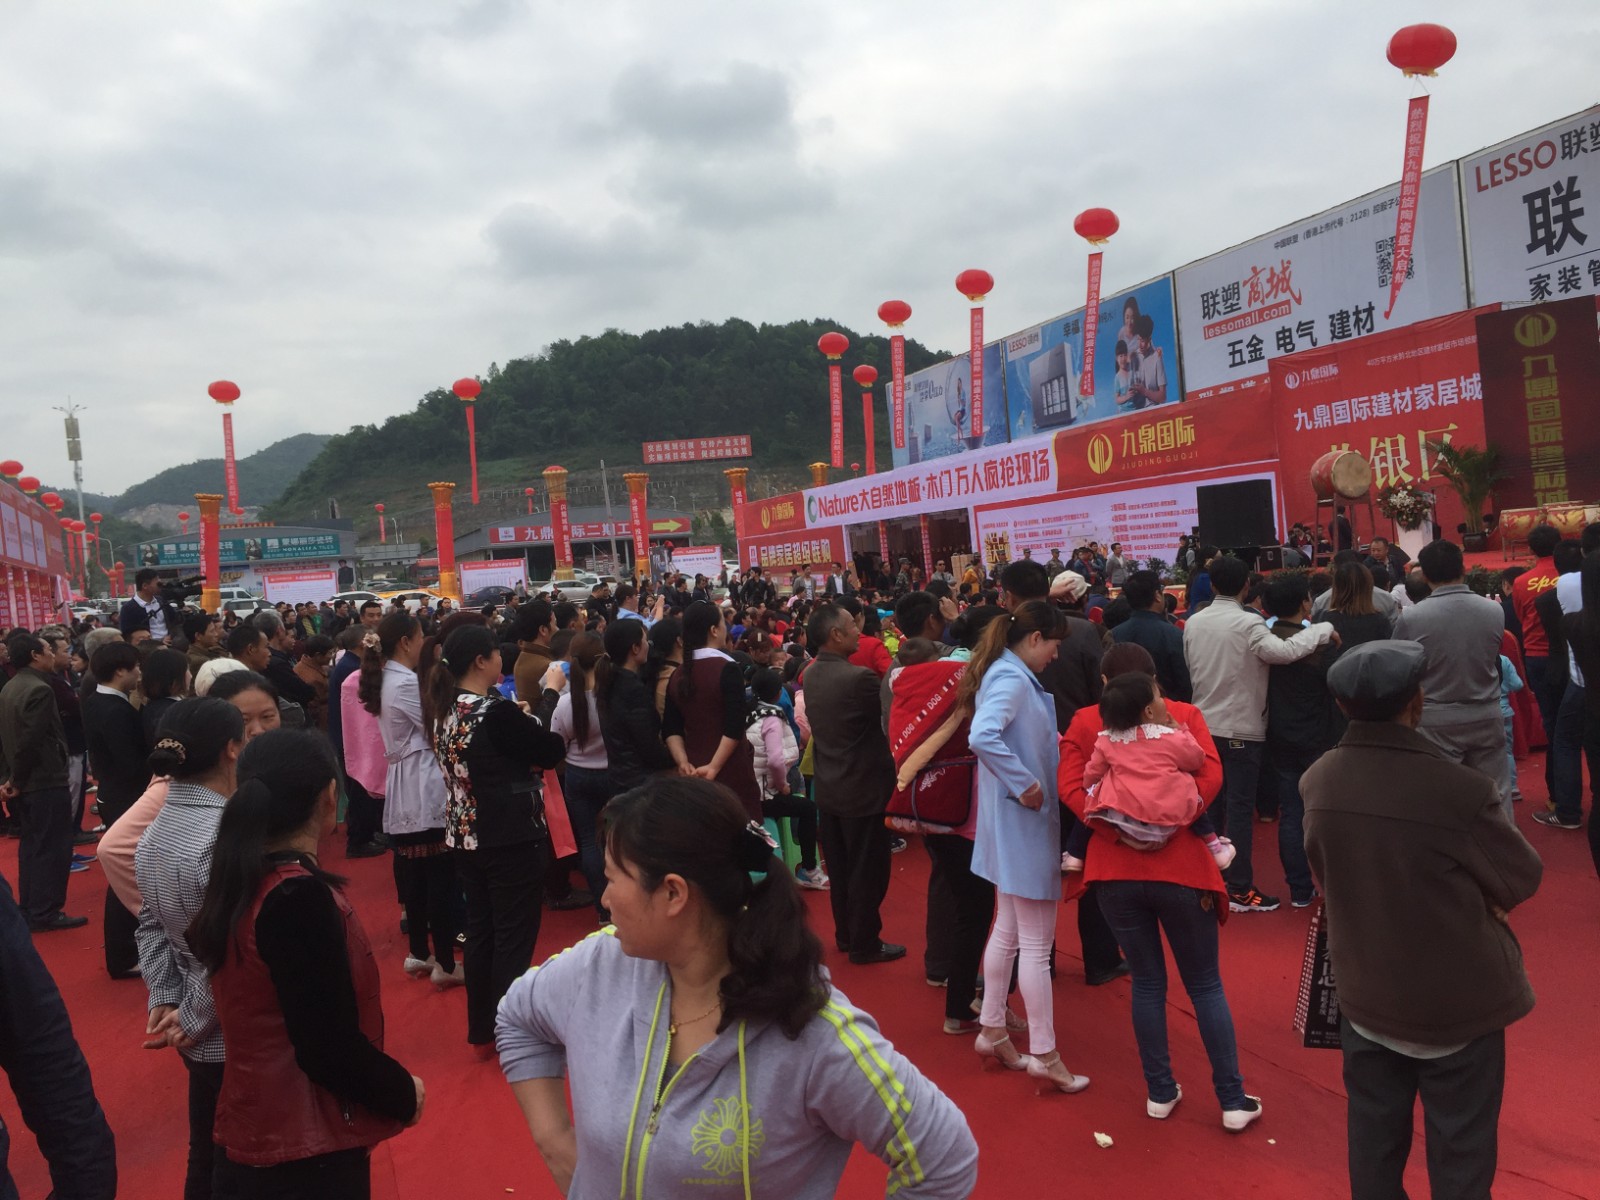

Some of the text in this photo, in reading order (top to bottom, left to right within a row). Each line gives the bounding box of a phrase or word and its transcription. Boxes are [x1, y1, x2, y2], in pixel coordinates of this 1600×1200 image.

[1475, 139, 1557, 193] LESSO
[1522, 175, 1588, 257] 联
[1203, 303, 1291, 340] lessomall.com
[1227, 301, 1376, 369] 五金 电气 建材
[1302, 363, 1339, 382] 九鼎国际
[1293, 372, 1484, 432] 九鼎国际建材家居城
[1120, 415, 1196, 458] 九鼎国际
[1121, 451, 1199, 471] JIUDING GUOJI
[818, 494, 859, 519] Nature
[955, 447, 1049, 497] 万人疯抢现场
[179, 541, 233, 551] 蒙娜瓷砖
[524, 522, 632, 542] 九鼎际二期工
[926, 693, 943, 710] DOG
[902, 722, 916, 739] DOG
